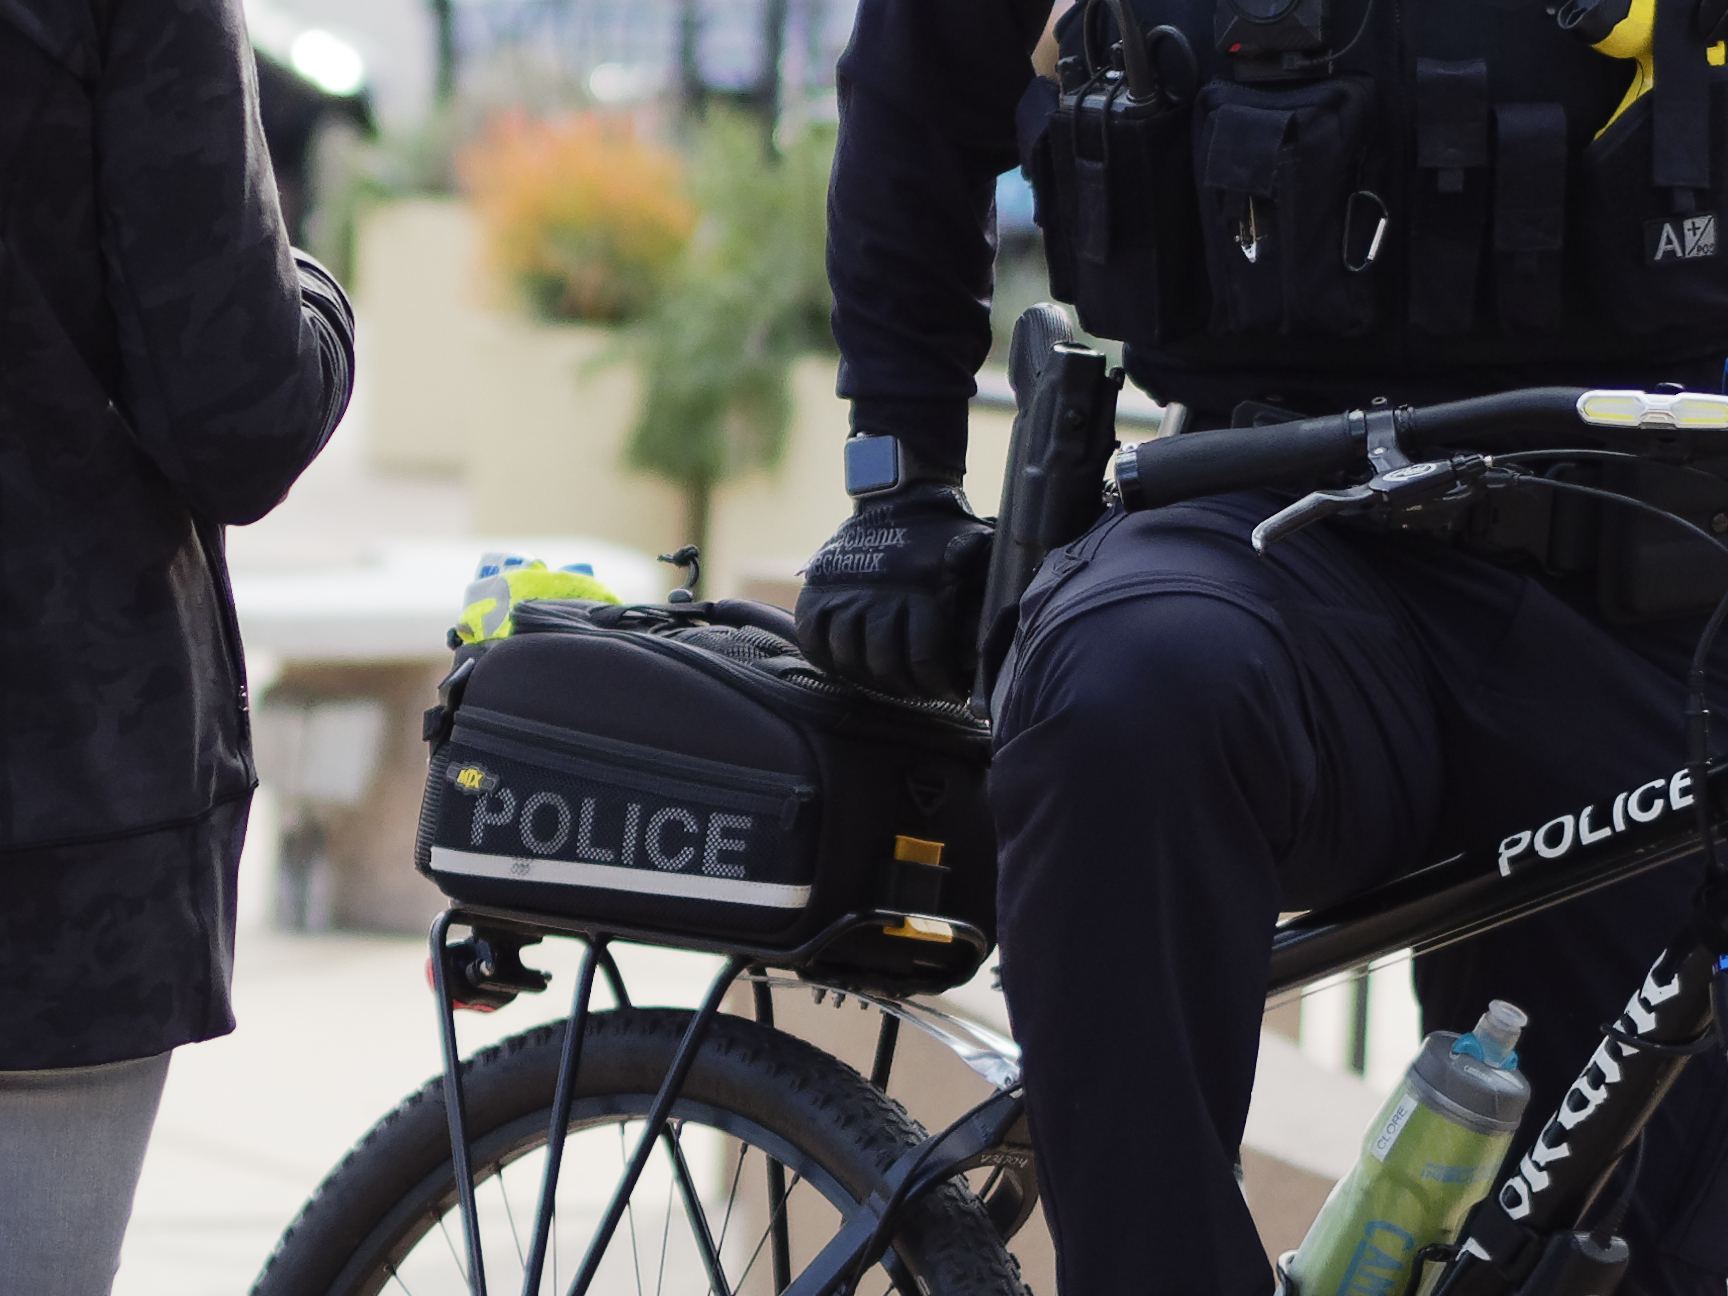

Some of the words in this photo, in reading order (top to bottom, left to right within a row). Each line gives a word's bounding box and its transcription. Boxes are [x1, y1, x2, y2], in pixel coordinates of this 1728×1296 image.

[1653, 222, 1685, 261] A
[470, 787, 754, 879] POLICE
[1498, 767, 1696, 878] POLICE
[1376, 1104, 1409, 1151] CLORE
